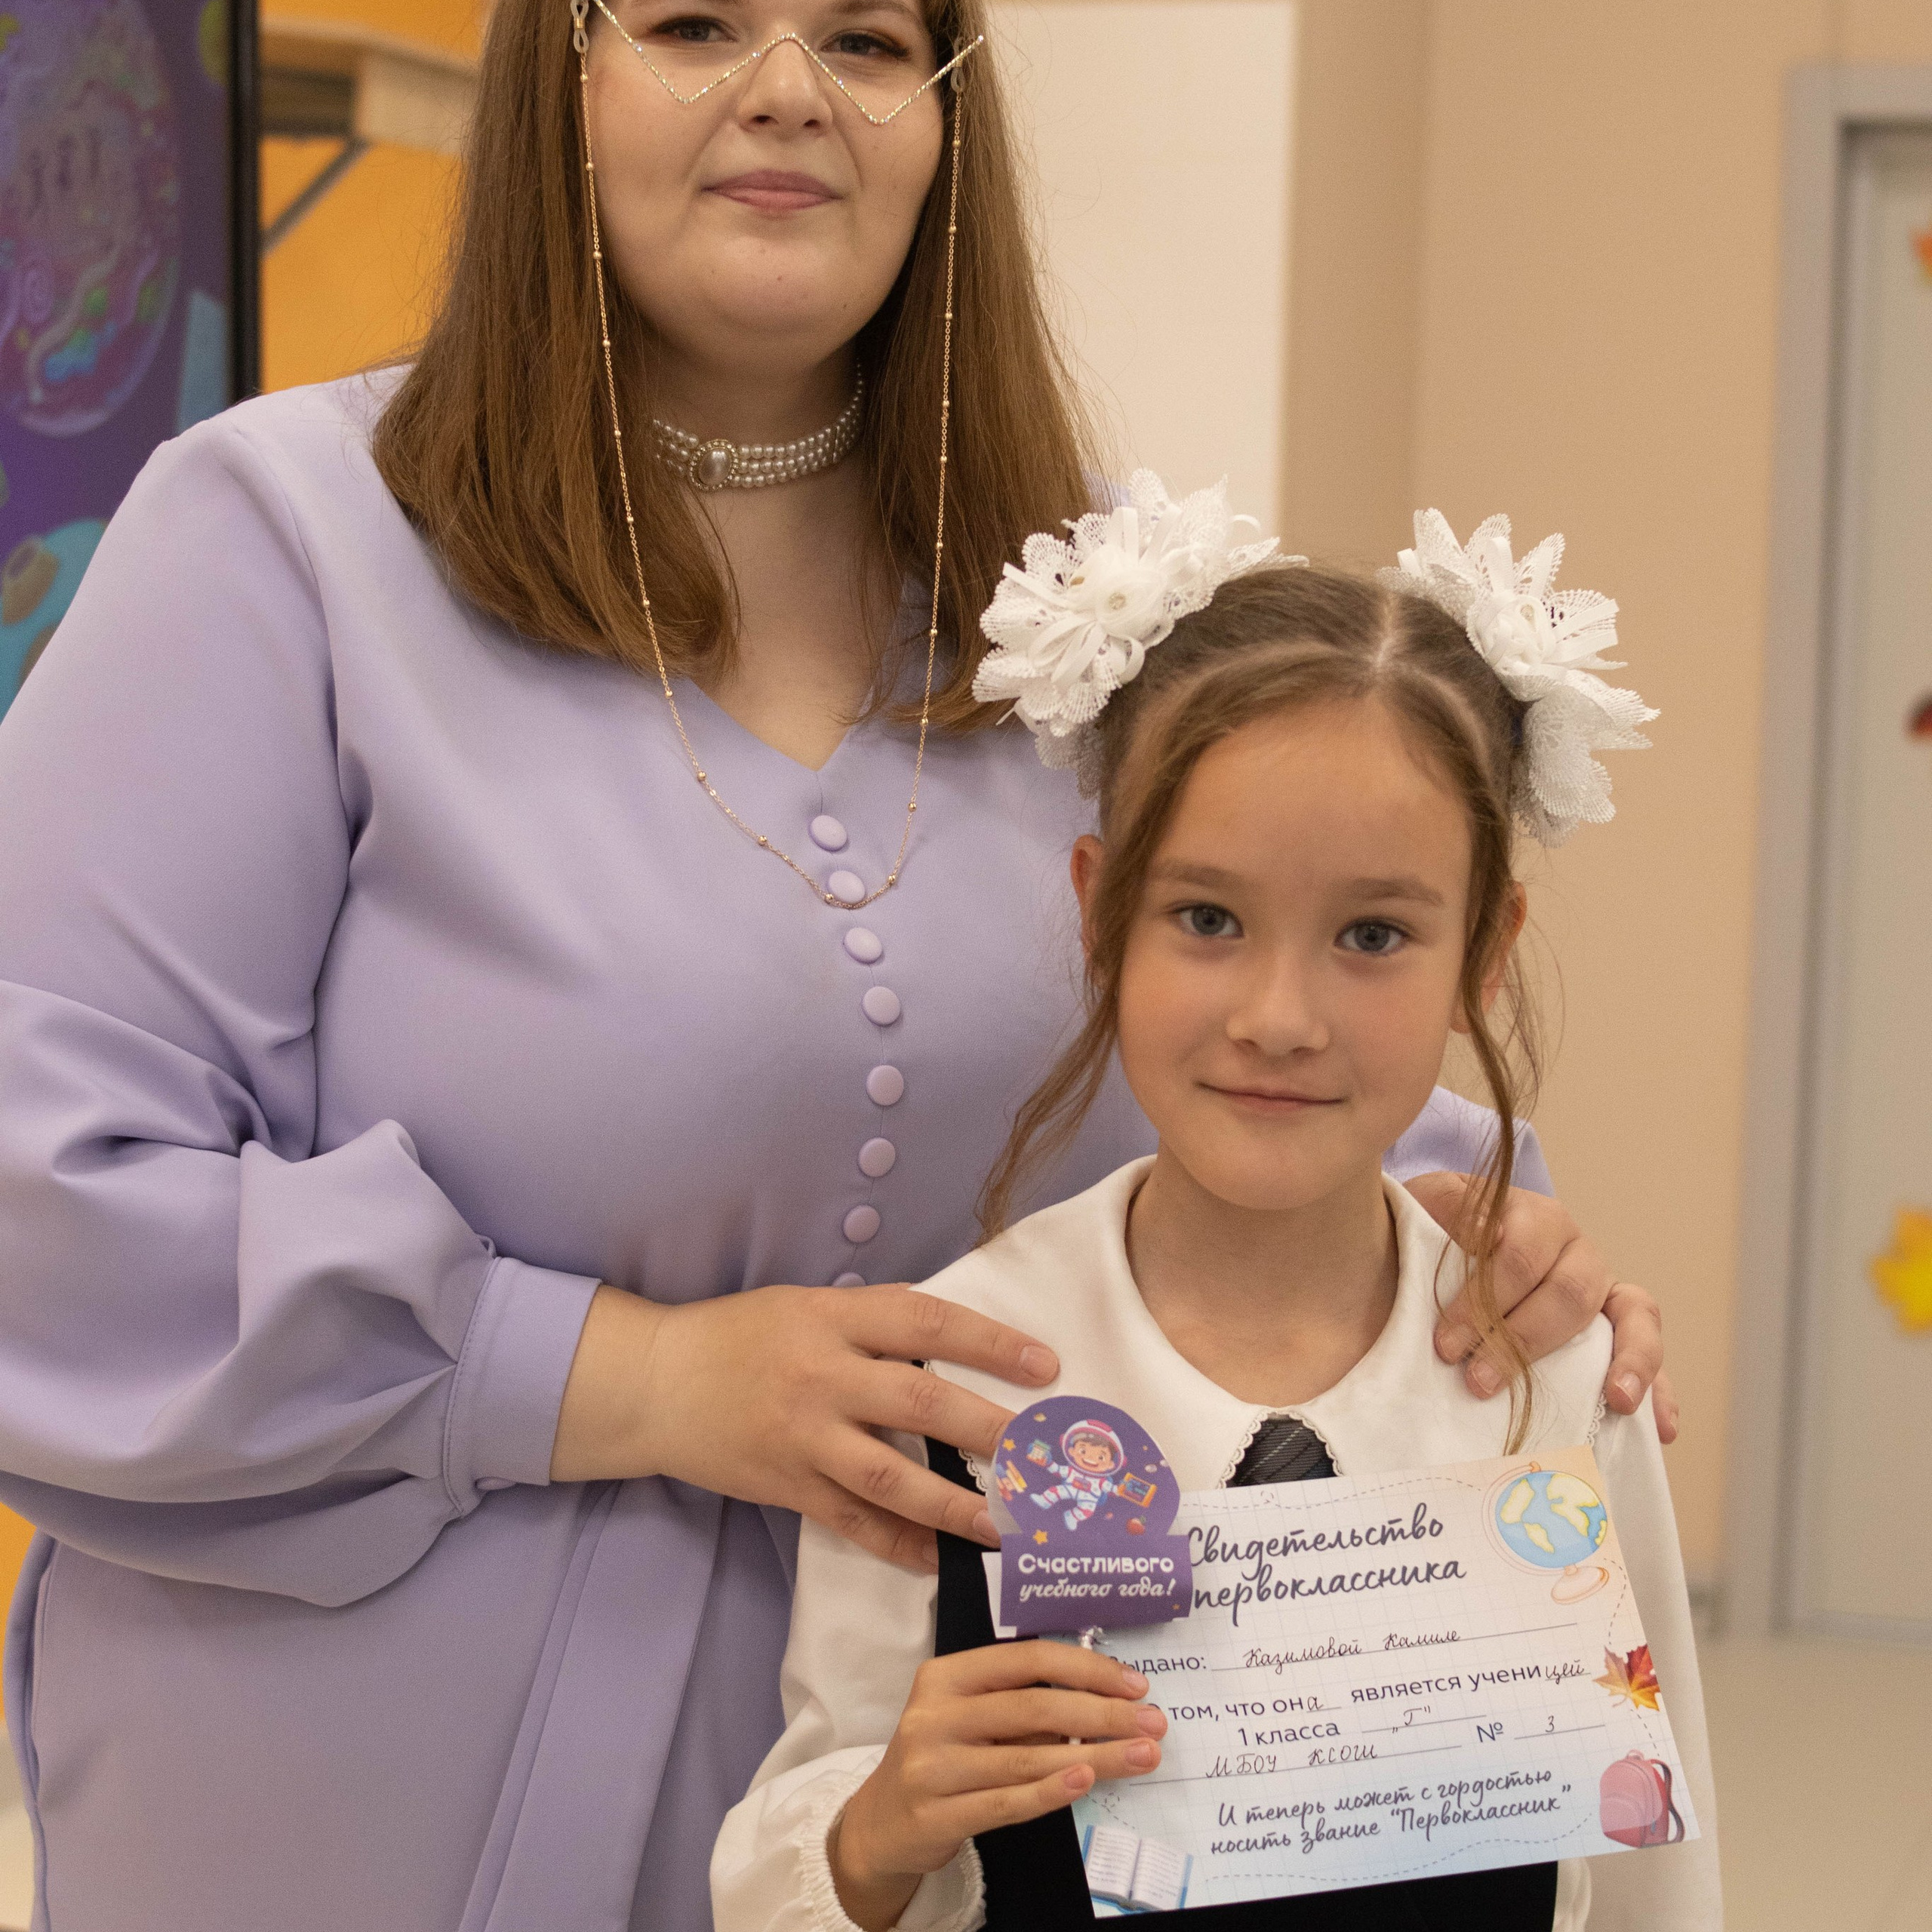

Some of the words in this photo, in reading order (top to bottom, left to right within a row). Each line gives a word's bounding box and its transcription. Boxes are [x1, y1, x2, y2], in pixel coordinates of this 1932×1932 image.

[1188, 1502, 1444, 1581] Свидетельство
[1018, 1554, 1174, 1574] Счастливого
[1019, 1577, 1110, 1602] учебного
[1119, 1576, 1176, 1597] года!
[1194, 1560, 1467, 1627] первоклассника
[1383, 1629, 1460, 1651] Камиле
[1168, 1705, 1220, 1721] том,
[1226, 1702, 1265, 1717] что
[1351, 1675, 1461, 1703] является
[1238, 1727, 1248, 1746] 1
[1256, 1721, 1340, 1746] класса
[1476, 1721, 1504, 1743] №
[1218, 1802, 1237, 1826] И
[1245, 1798, 1325, 1829] теперь
[1334, 1786, 1415, 1812] может
[1422, 1787, 1432, 1800] с
[1437, 1770, 1552, 1807] гордостью
[1210, 1833, 1291, 1854] носить
[1300, 1818, 1381, 1854] звание
